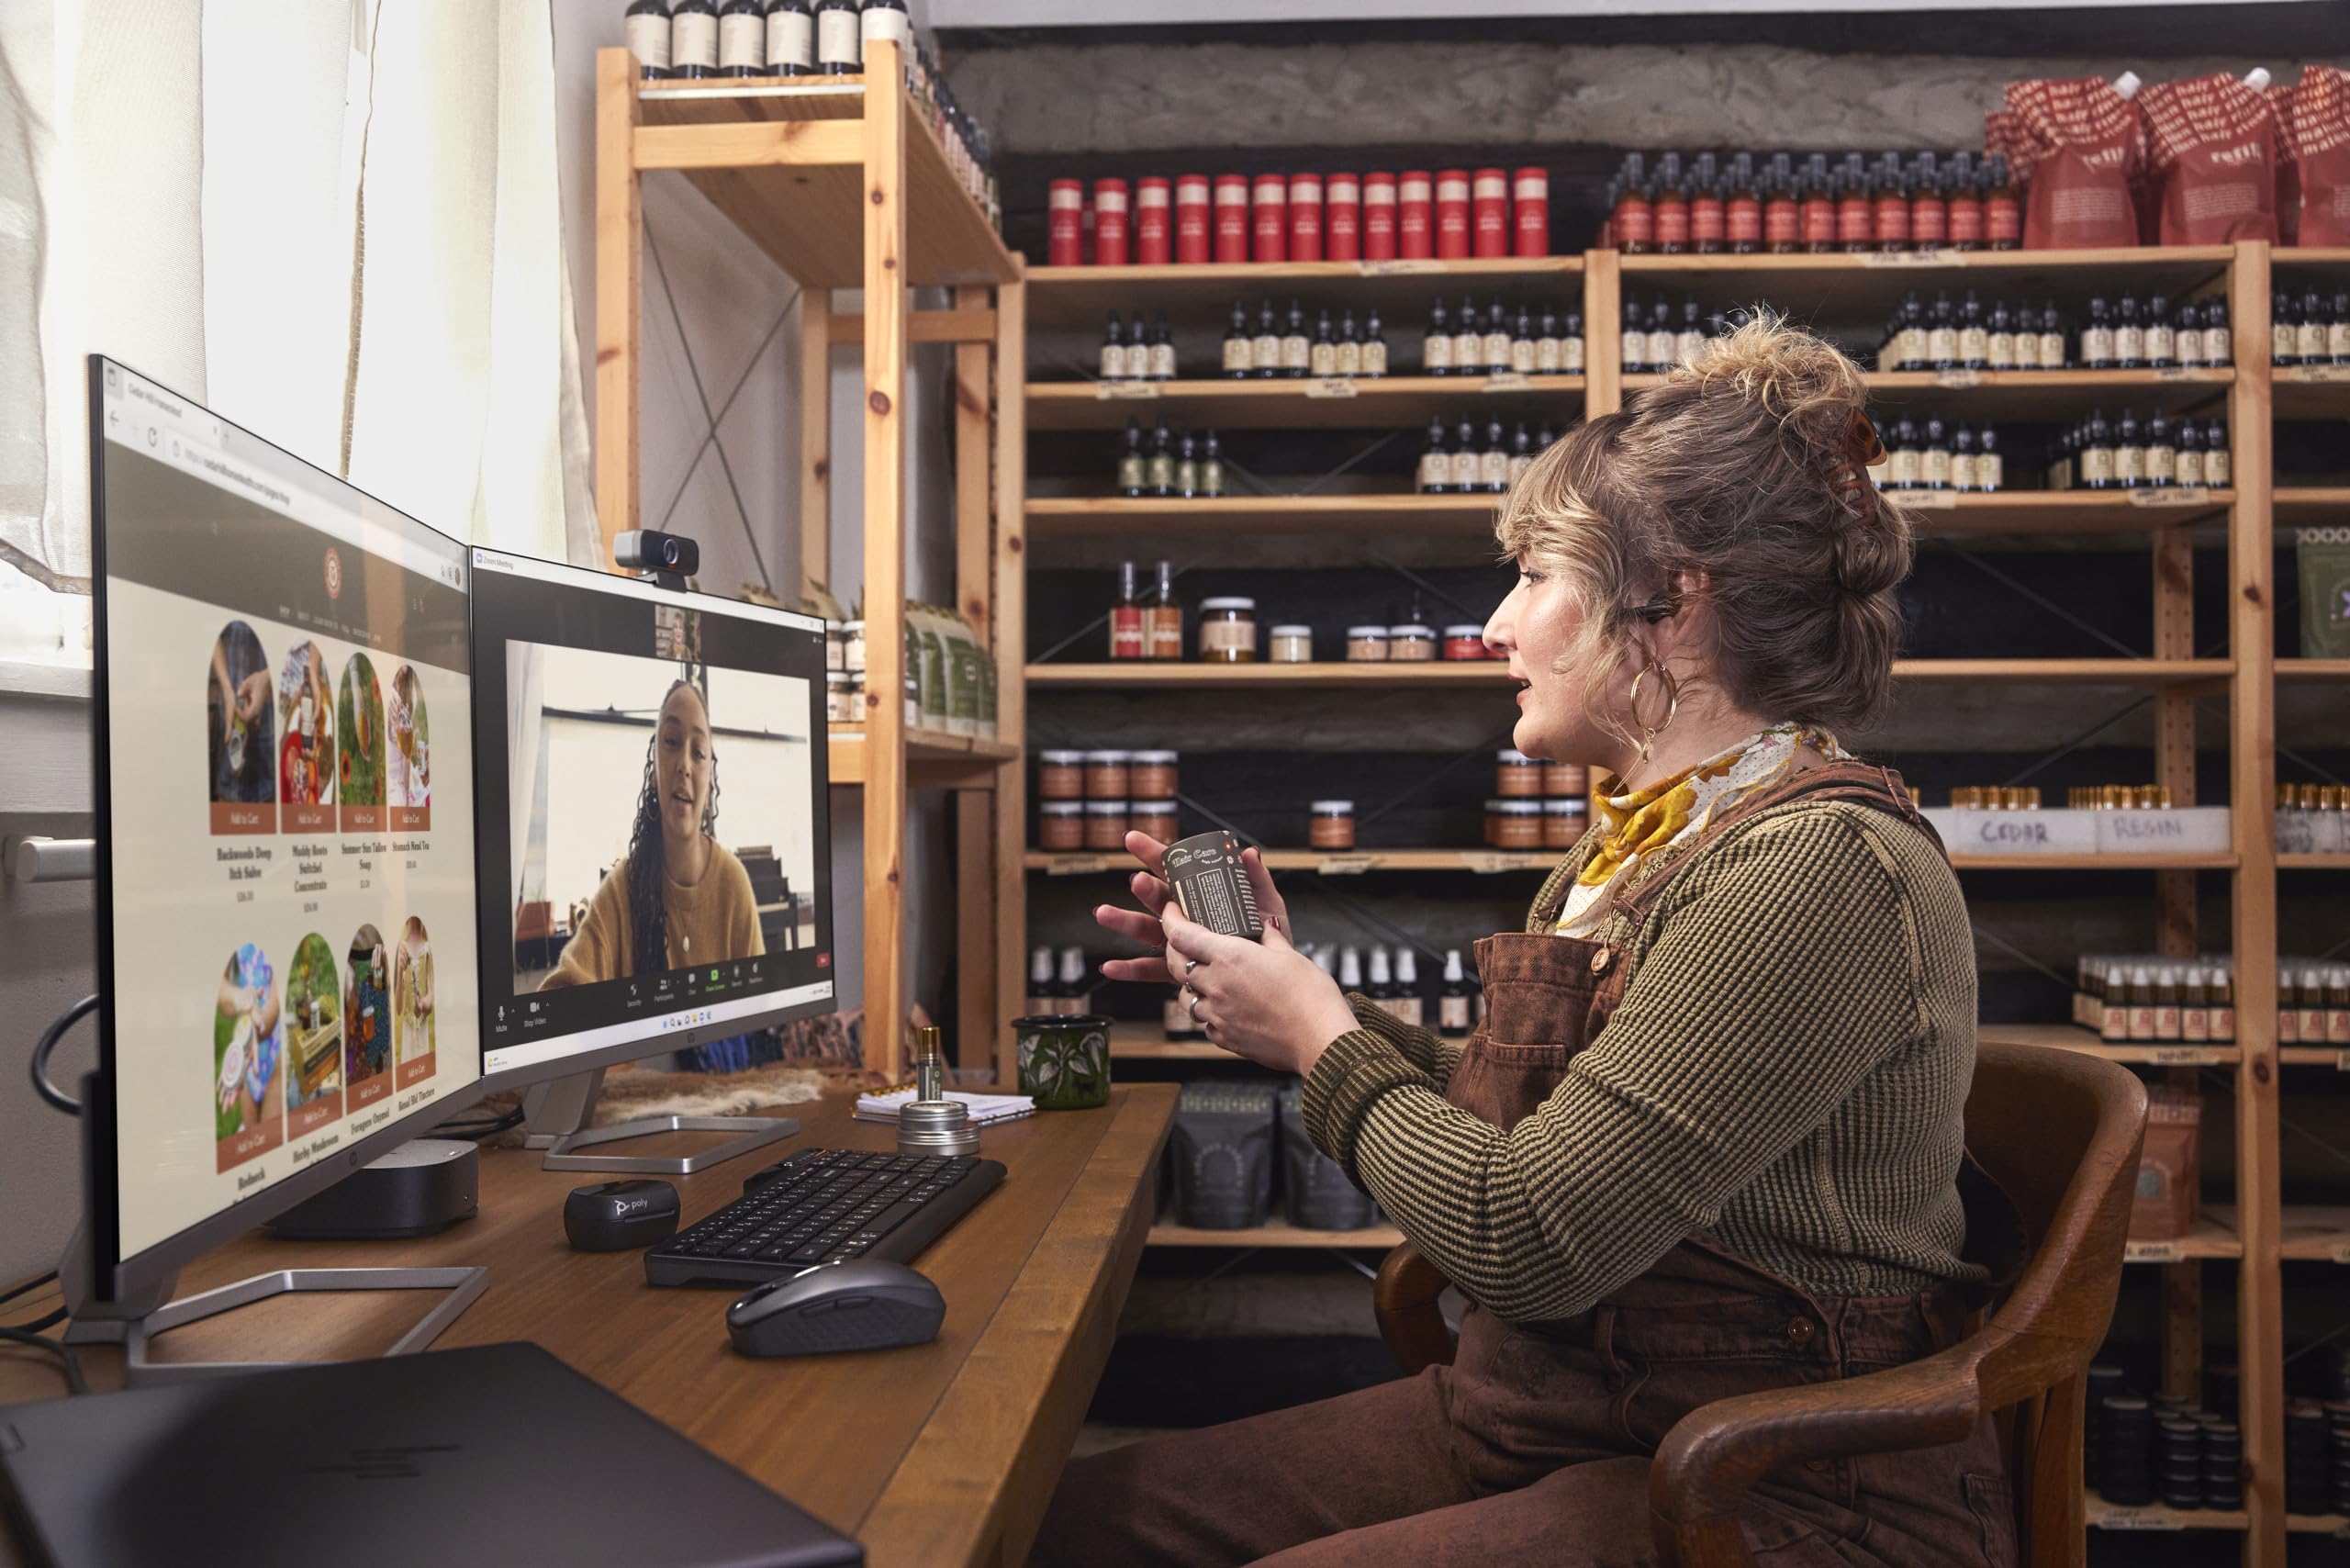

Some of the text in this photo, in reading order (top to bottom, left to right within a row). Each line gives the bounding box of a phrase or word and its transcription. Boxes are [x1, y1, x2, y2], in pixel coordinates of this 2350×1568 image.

[484, 556, 514, 570] Zoom Meeting
[1979, 820, 2049, 844] CEDAR
[393, 841, 409, 851] Stomach
[1193, 848, 1216, 859] Care
[360, 858, 371, 871] Soap
[295, 880, 327, 892] Concentrate
[632, 1198, 648, 1210] poly
